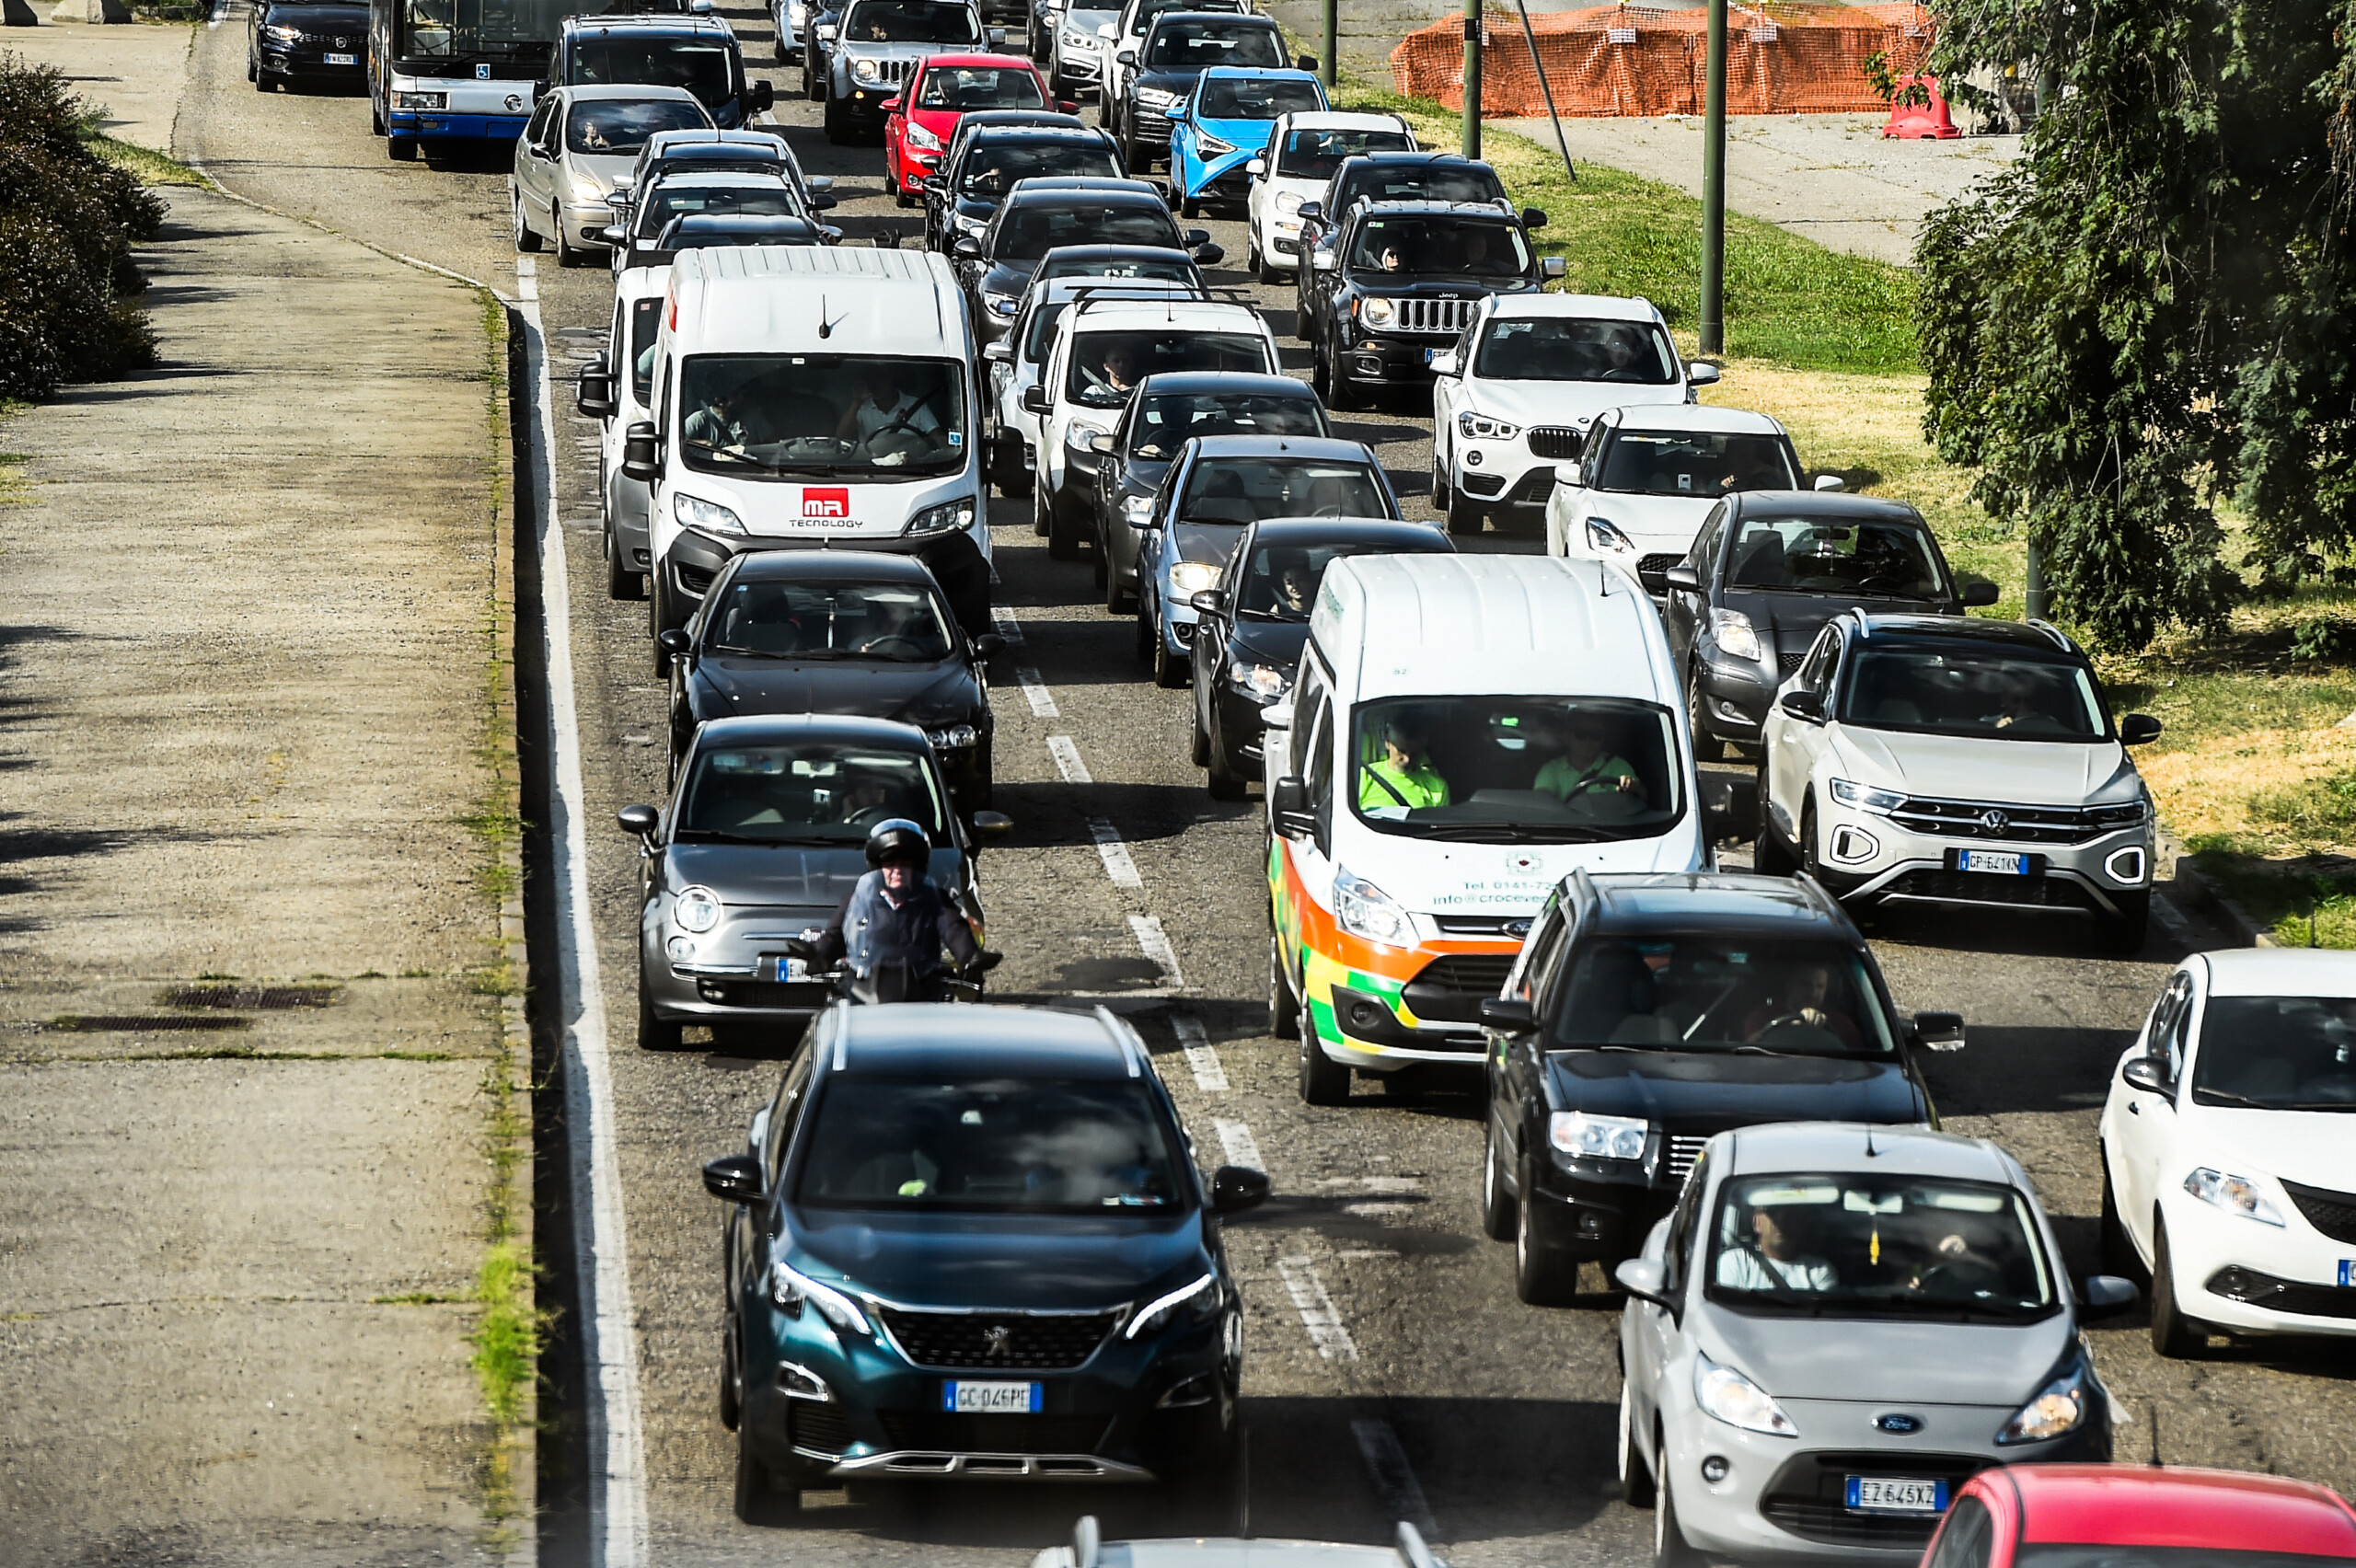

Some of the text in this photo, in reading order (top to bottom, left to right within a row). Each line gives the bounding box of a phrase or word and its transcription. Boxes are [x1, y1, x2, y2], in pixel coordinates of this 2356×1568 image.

[803, 500, 844, 516] MR
[789, 519, 863, 528] TECNOLOGY
[1494, 881, 1556, 892] 0141-72
